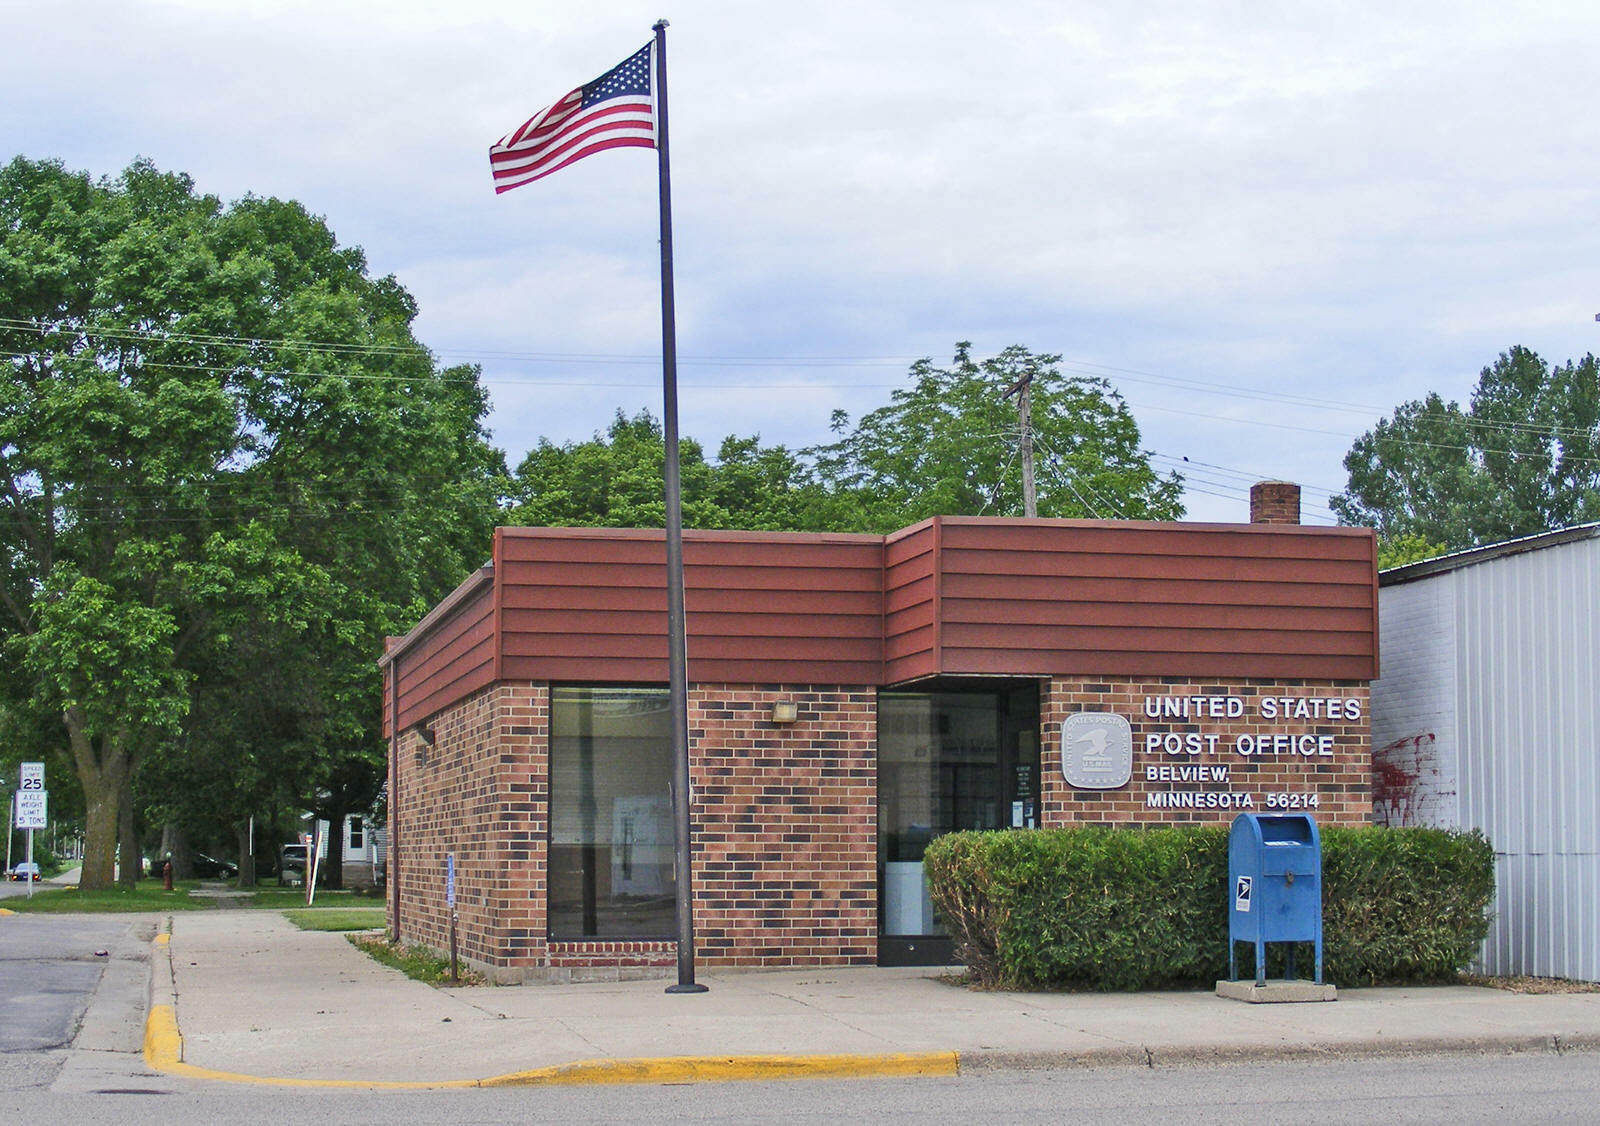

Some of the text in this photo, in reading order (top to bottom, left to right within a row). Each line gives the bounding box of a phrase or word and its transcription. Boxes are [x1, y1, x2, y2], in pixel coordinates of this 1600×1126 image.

[1145, 696, 1361, 720] UNITED STATES
[1146, 733, 1334, 756] POST OFFICE
[1146, 766, 1230, 784] BELVIEW,
[23, 778, 42, 790] 25
[1147, 792, 1320, 809] MINNESOTA 56214
[19, 817, 45, 825] 5 TONS
